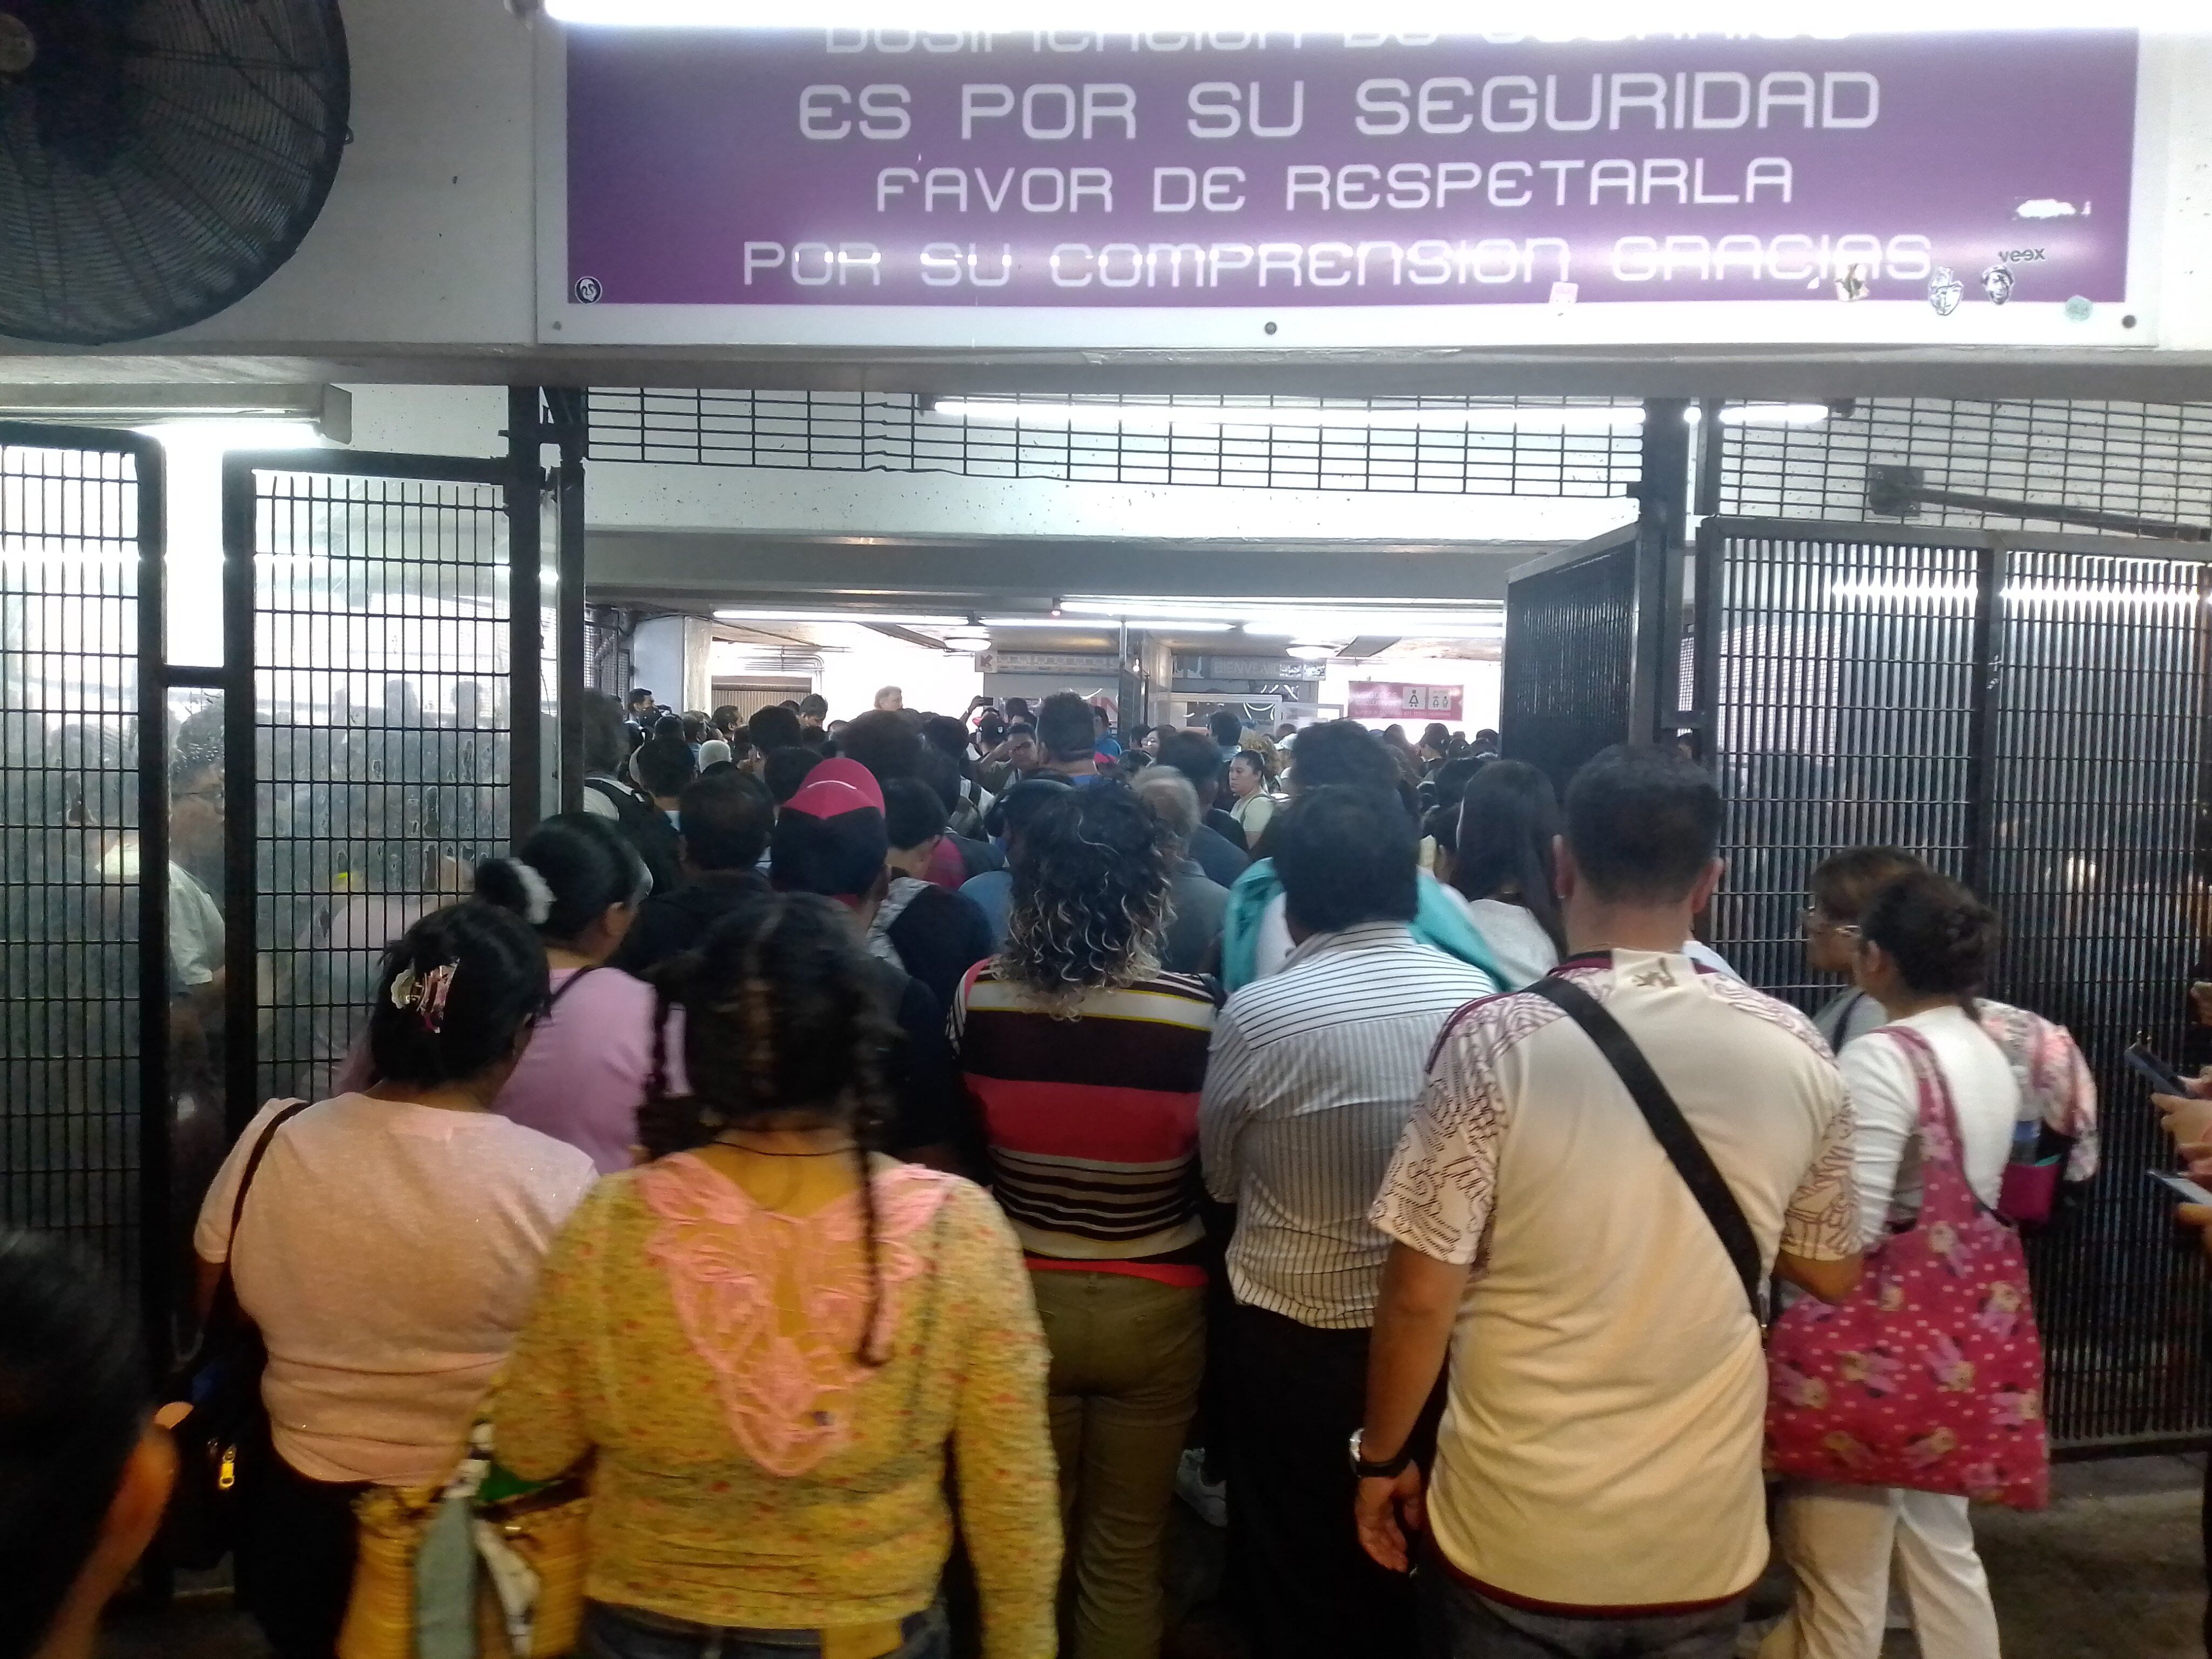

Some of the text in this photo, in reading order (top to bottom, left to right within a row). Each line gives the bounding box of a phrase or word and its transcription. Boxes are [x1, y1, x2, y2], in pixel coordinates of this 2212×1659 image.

[799, 71, 1880, 140] ES POR SU SEGURIDAD
[876, 156, 1794, 212] FAVOR DE RESPETARLA
[743, 233, 1932, 288] POR SU COMPRENSION GRACIAS
